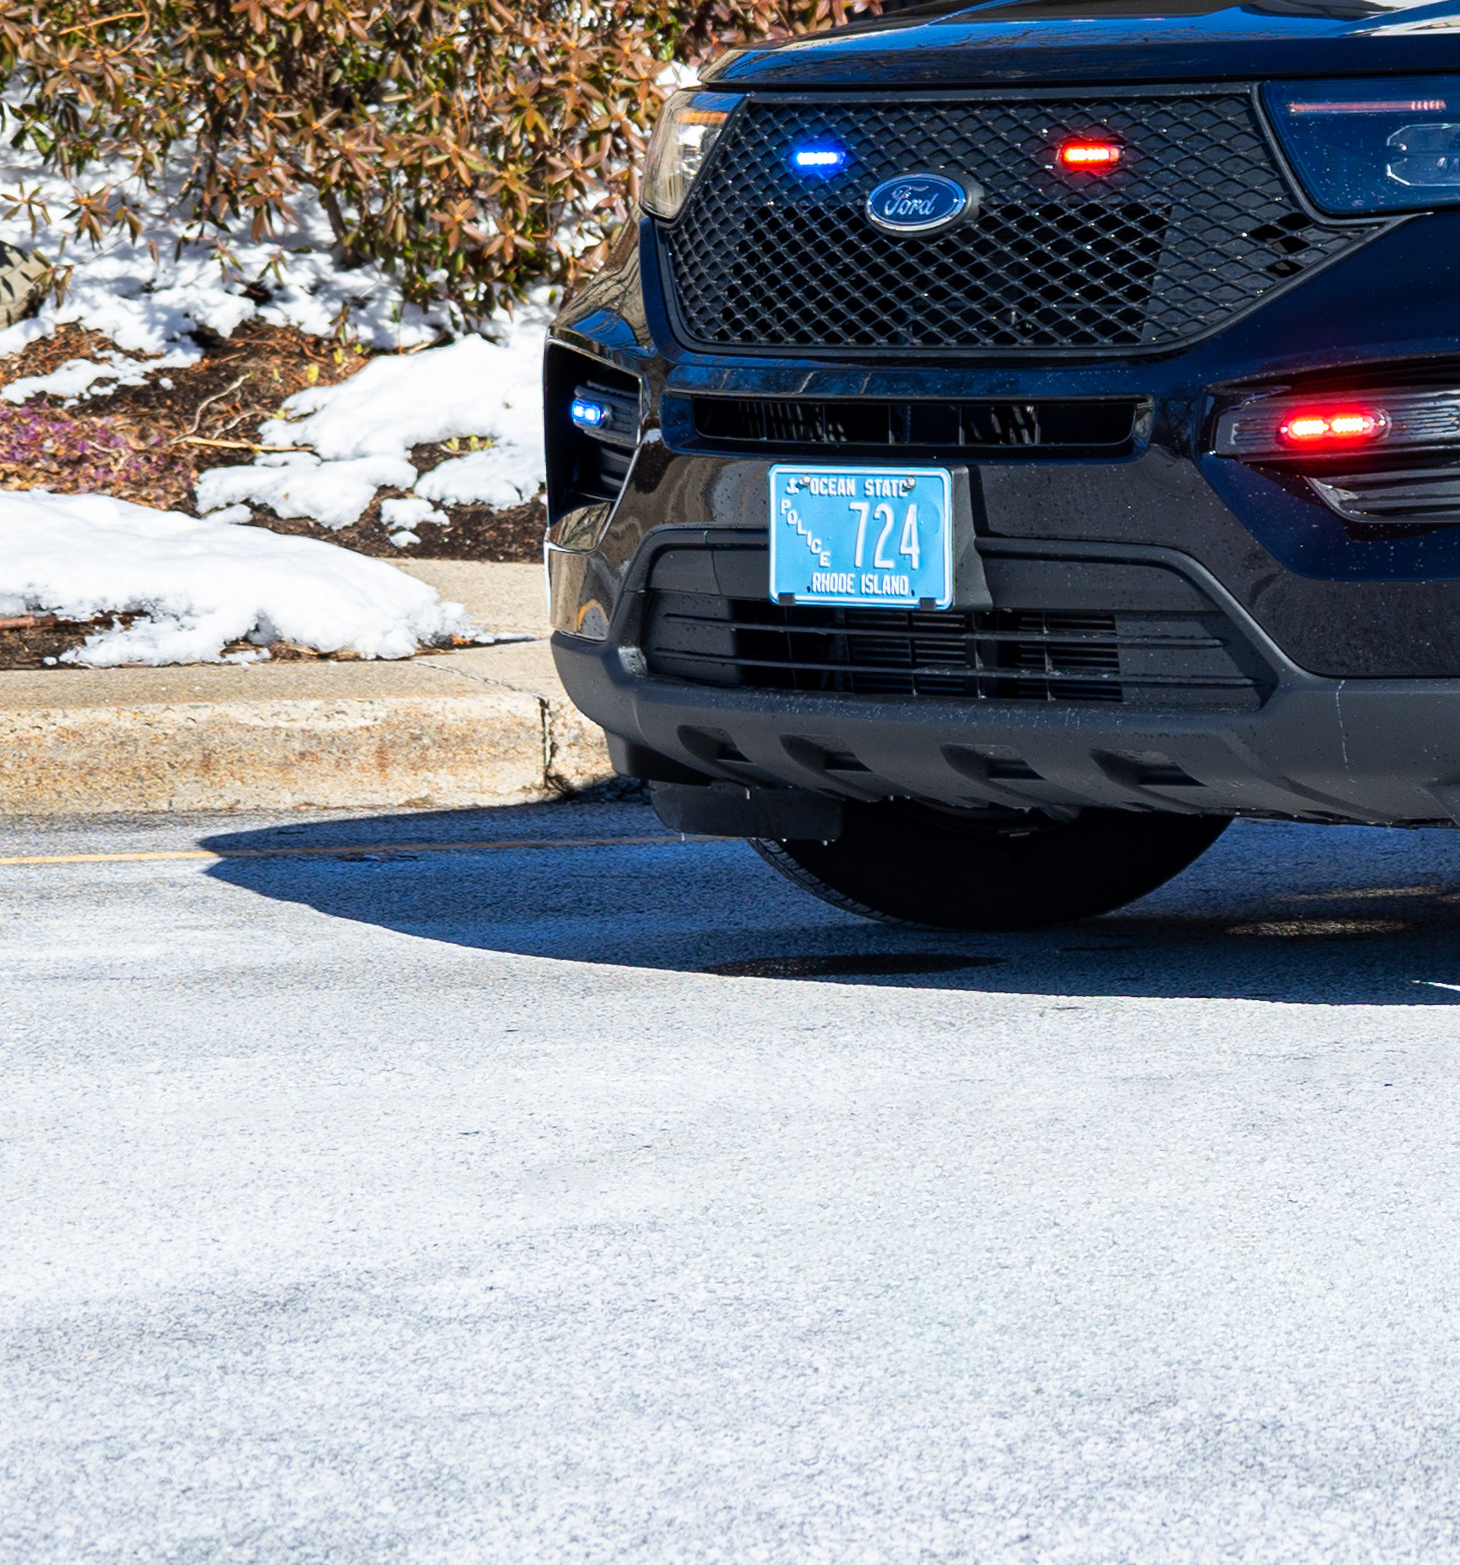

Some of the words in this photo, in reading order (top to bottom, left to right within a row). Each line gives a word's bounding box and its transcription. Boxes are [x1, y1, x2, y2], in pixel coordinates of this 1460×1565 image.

[884, 185, 940, 216] Ford
[810, 478, 856, 496] OCEAN
[780, 498, 831, 568] POLICE
[849, 501, 920, 570] 724
[811, 572, 856, 594] RHODE
[861, 573, 909, 596] ISLAND
